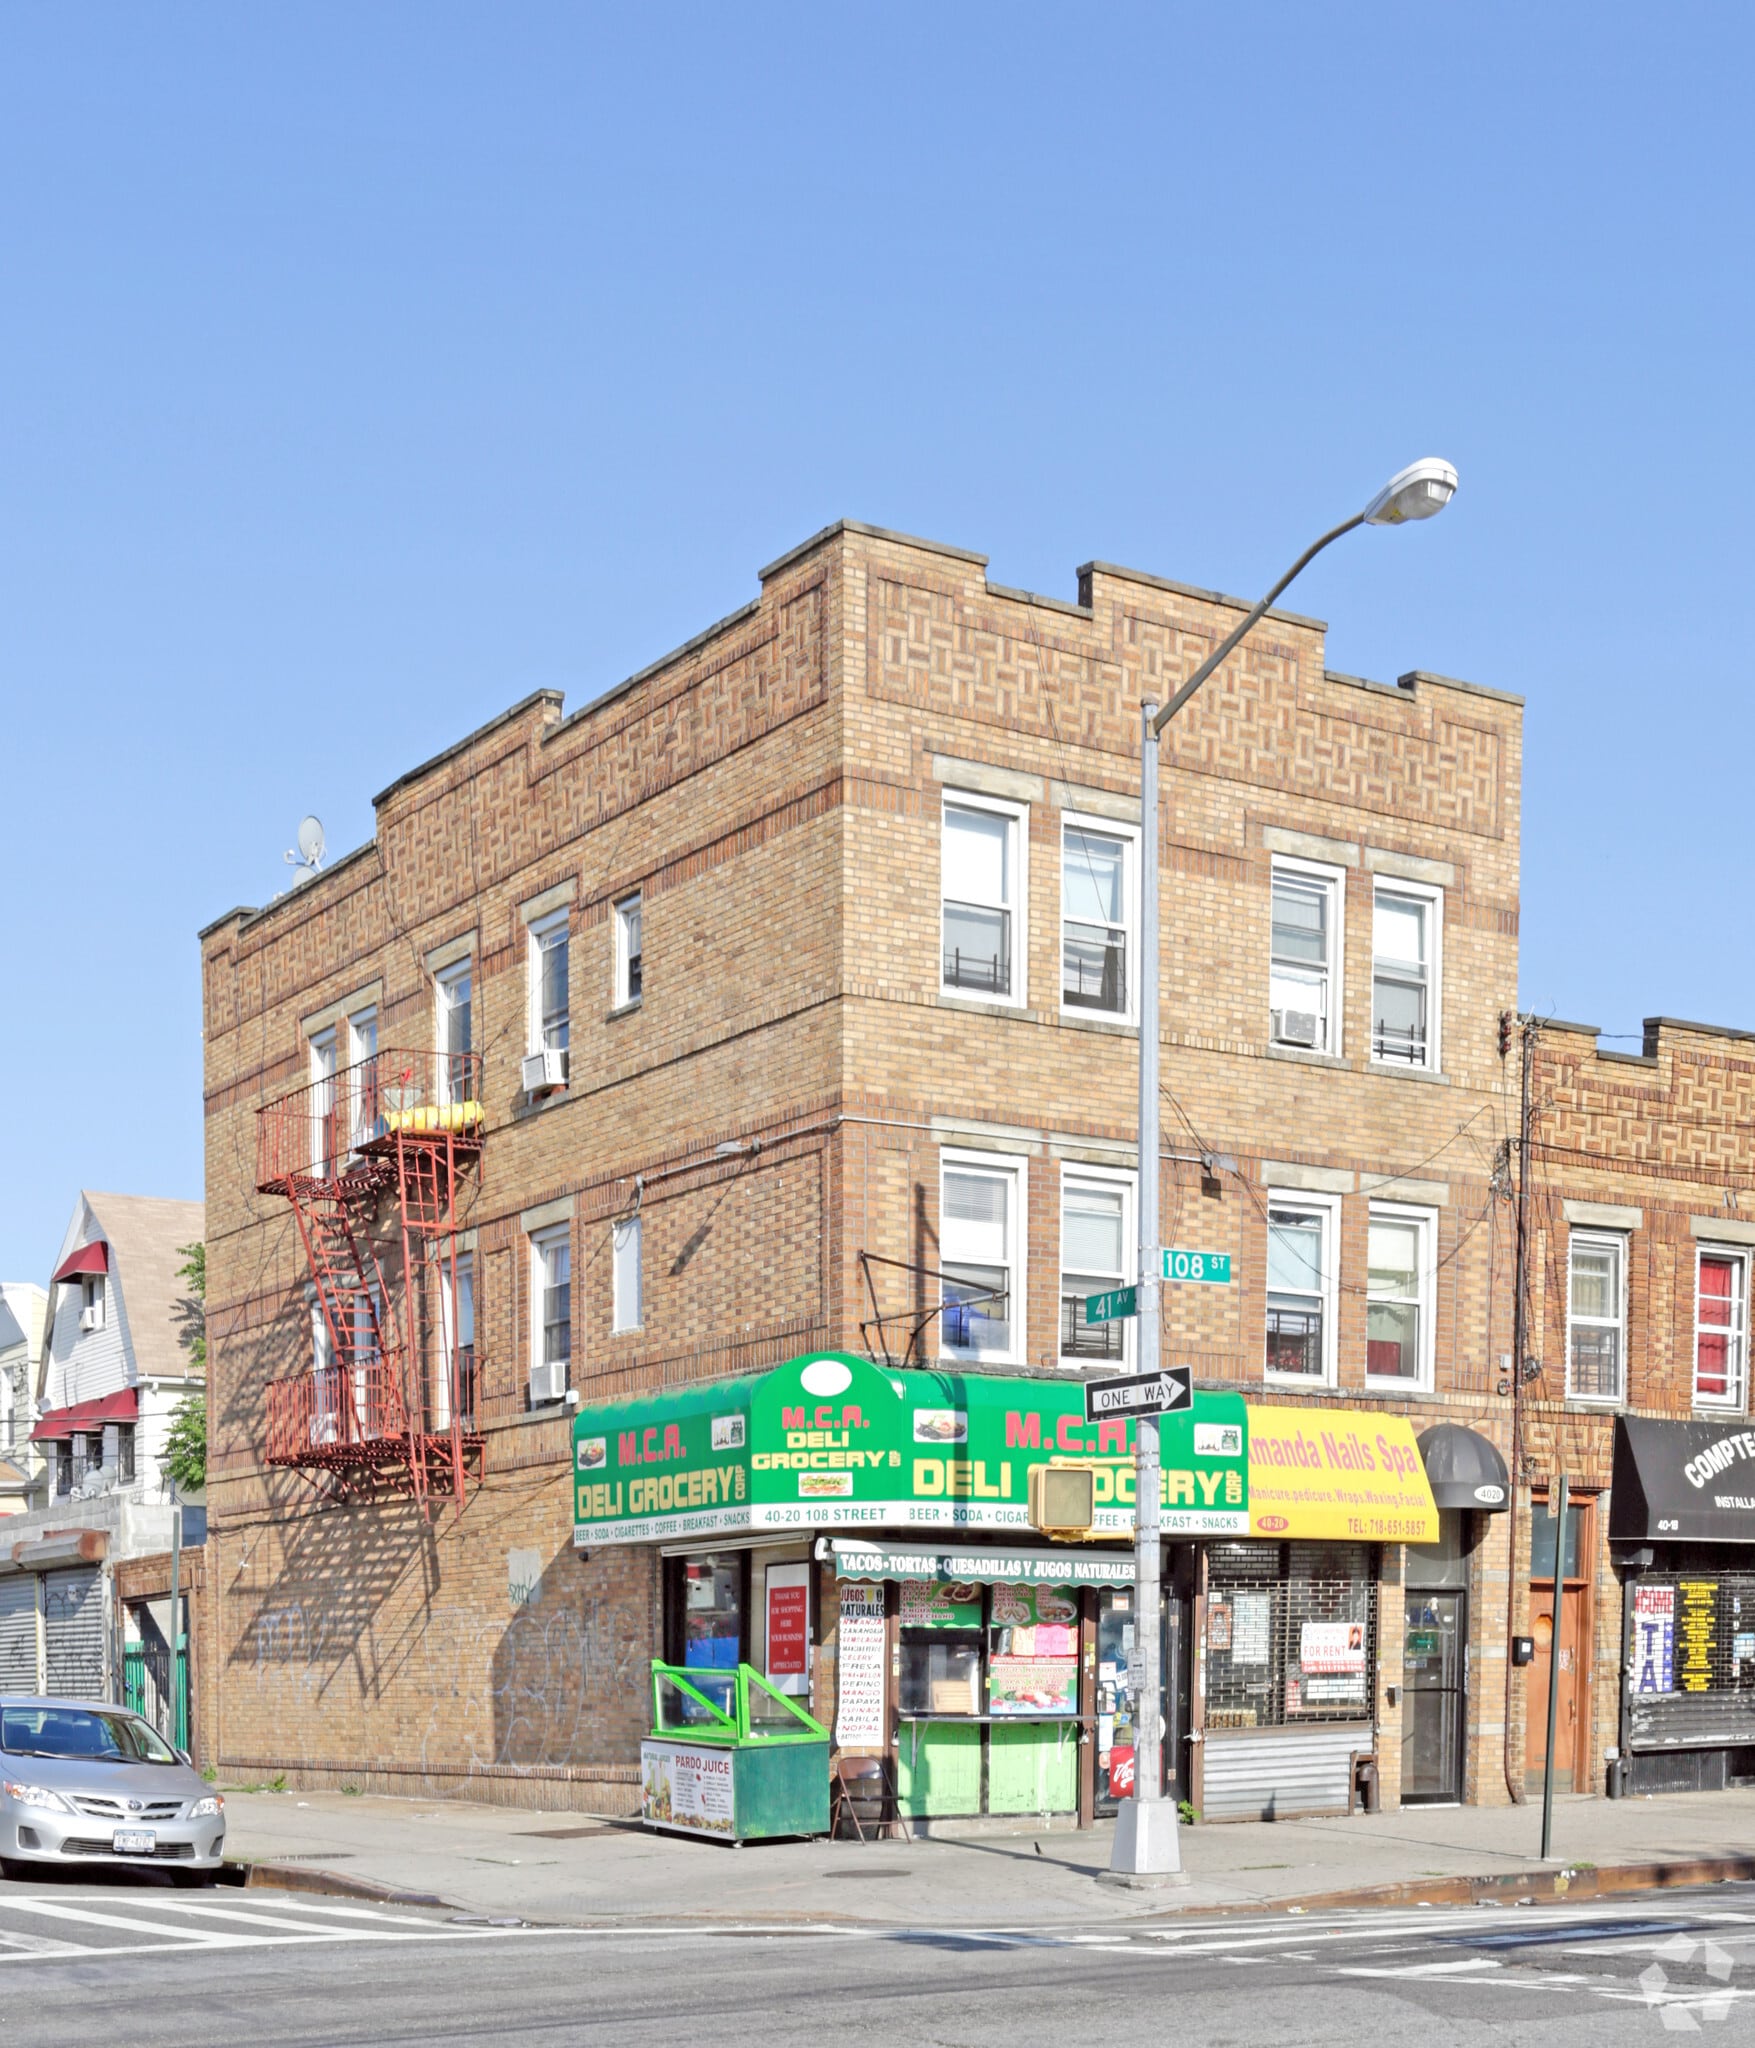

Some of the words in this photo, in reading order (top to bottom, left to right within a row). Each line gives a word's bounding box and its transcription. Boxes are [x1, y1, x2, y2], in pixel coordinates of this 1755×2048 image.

[1166, 1253, 1204, 1279] 108
[1211, 1256, 1225, 1270] ST
[1095, 1294, 1112, 1319] 41
[1116, 1291, 1129, 1305] AV
[1101, 1389, 1130, 1408] ONE
[1144, 1382, 1175, 1401] WAY
[782, 1405, 870, 1429] M.C.A.
[618, 1424, 687, 1466] M.C.A.
[787, 1431, 849, 1448] DELI
[751, 1451, 885, 1470] GROCERY
[1321, 1431, 1376, 1472] Nails
[1376, 1433, 1418, 1482] Spa
[1684, 1432, 1755, 1488] COMPTE
[578, 1482, 622, 1519] DELI
[629, 1465, 734, 1513] GROCERY
[913, 1458, 1012, 1498] DELI
[1094, 1467, 1223, 1505] OCRY
[1481, 1489, 1501, 1500] 4020
[576, 1529, 589, 1541] BEER
[594, 1528, 609, 1540] SODA
[615, 1524, 649, 1538] CIGARETTES
[655, 1521, 677, 1534] COFFEE
[683, 1515, 717, 1531] BREAKFAST
[724, 1512, 750, 1526] SNACKS
[765, 1510, 801, 1522] 40-20
[806, 1509, 829, 1521] 108
[833, 1508, 887, 1521] STREET
[909, 1508, 940, 1521] BEER
[953, 1508, 983, 1521] SODA
[1130, 1515, 1191, 1528] BKFAST
[1202, 1517, 1238, 1529] SNACKS
[1262, 1518, 1284, 1529] 40-20
[1348, 1518, 1367, 1534] TEL:
[840, 1554, 883, 1572] TACOS
[888, 1556, 937, 1574] TORTAS
[943, 1558, 1021, 1576] QUESADILLAS
[1023, 1561, 1032, 1577] Y
[1034, 1561, 1072, 1578] JUGOS
[1074, 1563, 1136, 1579] NATURALES
[841, 1589, 864, 1601] JUGOS
[840, 1603, 884, 1616] NATURALES
[1304, 1645, 1321, 1657] FOR
[1324, 1645, 1346, 1657] RENT
[675, 1755, 702, 1770] PARDO
[703, 1760, 729, 1774] JUICE
